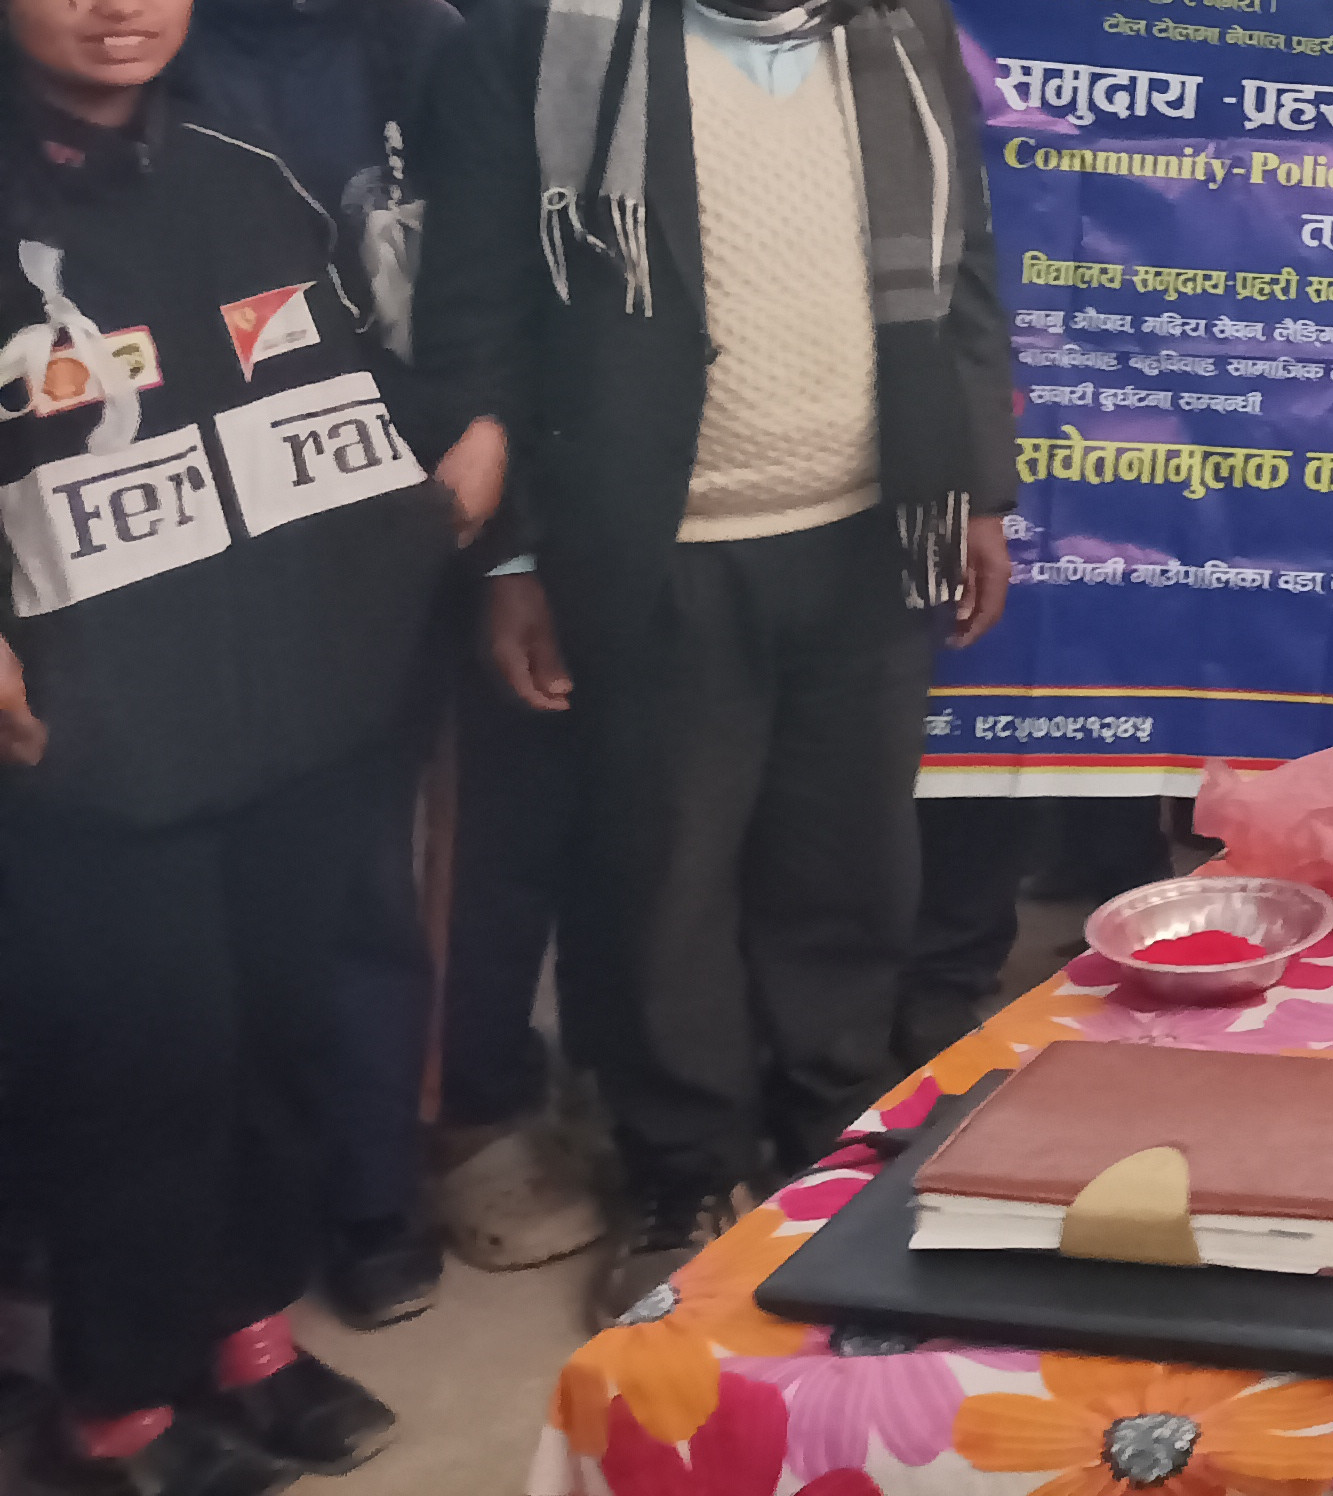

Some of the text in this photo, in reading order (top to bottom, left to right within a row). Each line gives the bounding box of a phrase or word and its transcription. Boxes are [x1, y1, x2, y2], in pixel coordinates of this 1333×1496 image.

[1102, 13, 1147, 36] टोल
[1152, 18, 1220, 44] टोलमा
[1225, 25, 1286, 51] नेपाल
[994, 57, 1204, 126] समुदाय
[1014, 425, 1293, 500] सचेतनामुलक
[52, 445, 207, 560] Fer
[1277, 570, 1326, 595] वडा
